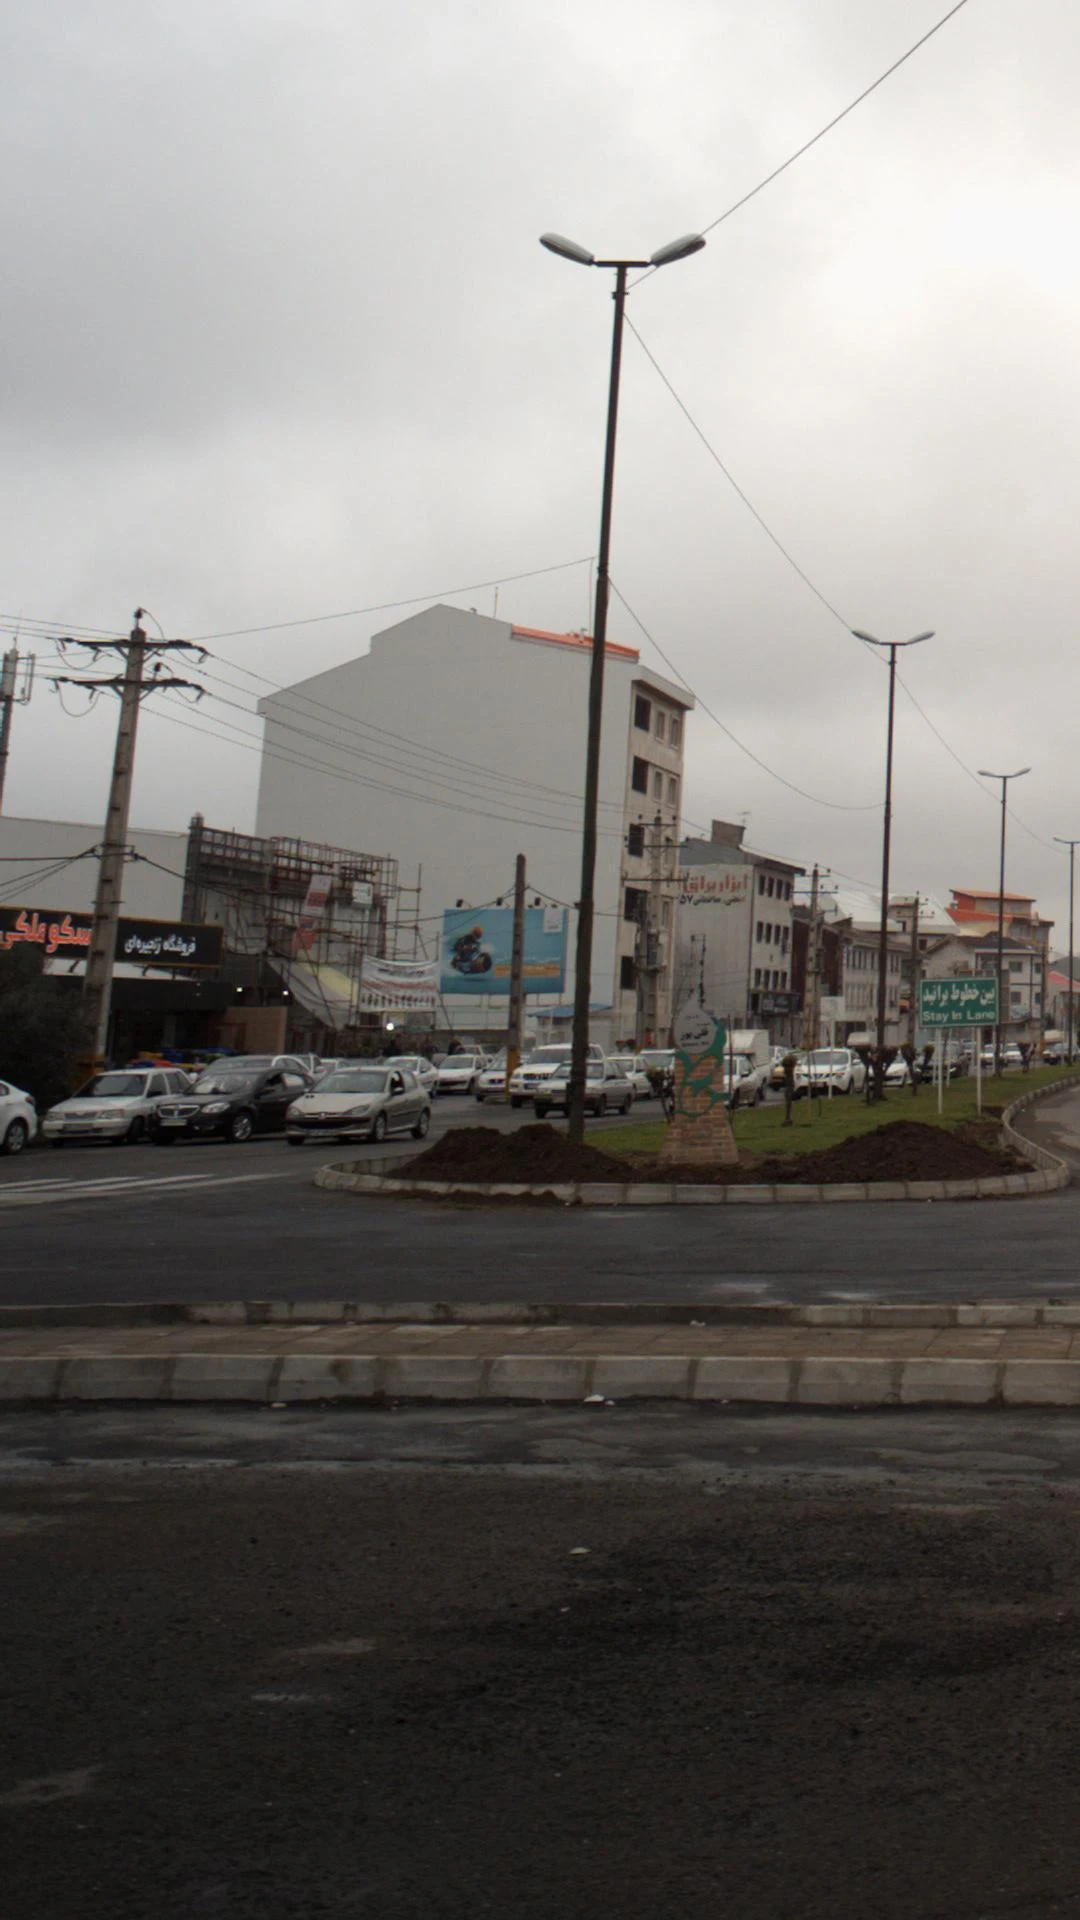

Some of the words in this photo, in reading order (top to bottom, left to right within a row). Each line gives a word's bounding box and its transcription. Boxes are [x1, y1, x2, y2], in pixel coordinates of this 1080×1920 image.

[922, 984, 949, 1007] برانید
[950, 983, 979, 1006] خطوط
[980, 987, 995, 1006] بین
[922, 1011, 949, 1023] Stay
[966, 1010, 996, 1020] Lane
